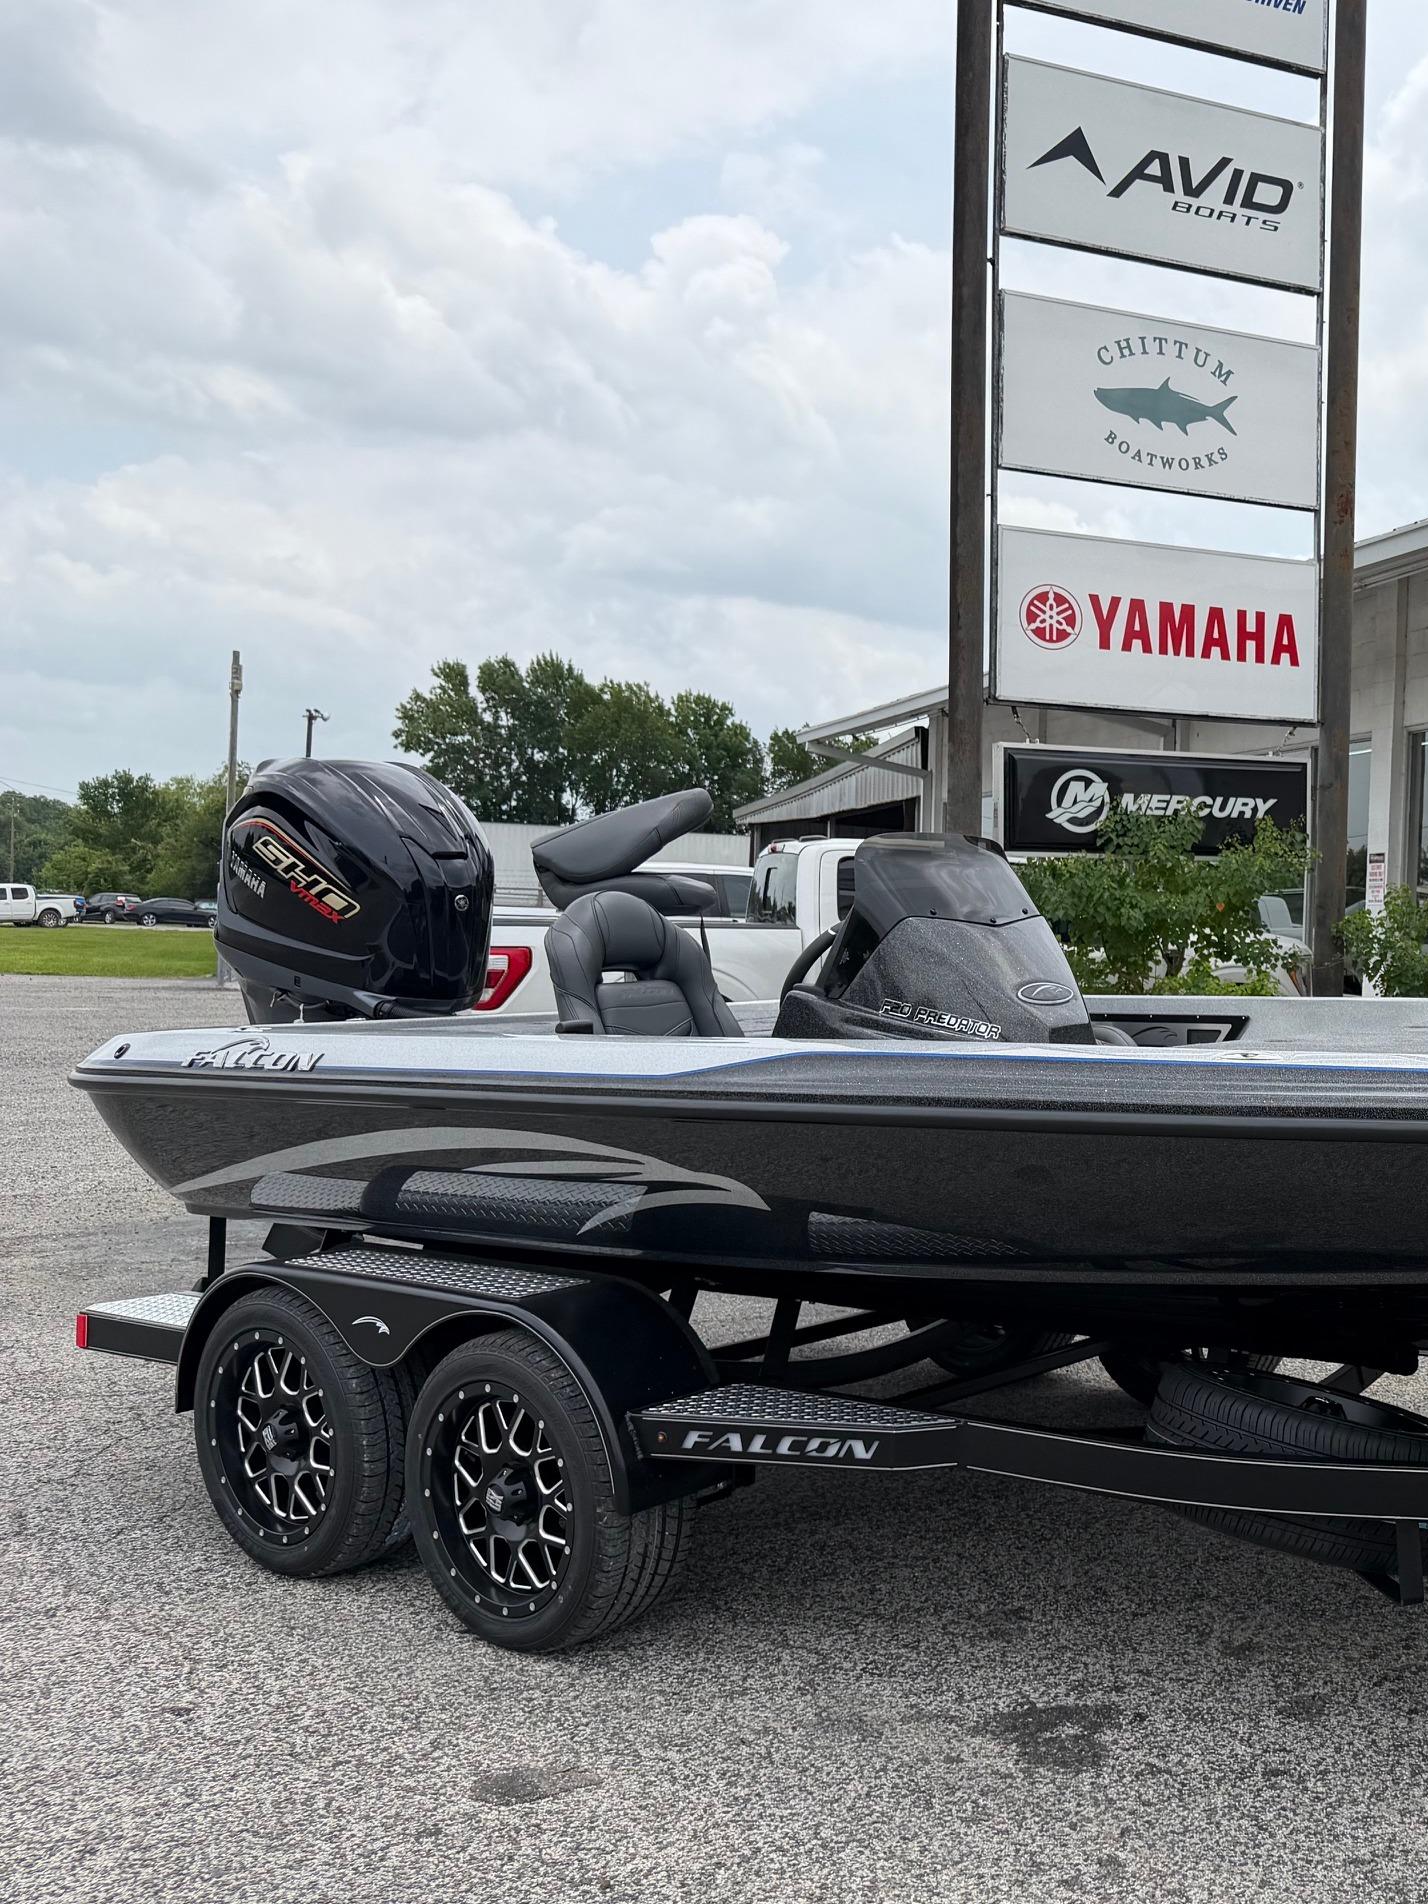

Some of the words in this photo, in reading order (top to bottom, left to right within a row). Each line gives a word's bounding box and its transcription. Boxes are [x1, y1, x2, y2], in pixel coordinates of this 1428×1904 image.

[1246, 0, 1306, 15] IVEN
[1106, 150, 1294, 214] AVID
[1171, 201, 1281, 232] BOATS
[1097, 336, 1234, 386] CHITTUM
[1104, 429, 1228, 471] BOATWORKS
[1088, 593, 1300, 667] YAMAHA
[1118, 793, 1278, 819] MERCURY
[230, 850, 267, 900] YAMAHA
[252, 836, 360, 919] SHO
[879, 998, 912, 1018] F20
[914, 1006, 1001, 1040] PREDATOR
[181, 1049, 324, 1072] FALCON
[682, 1430, 880, 1459] FALCON
